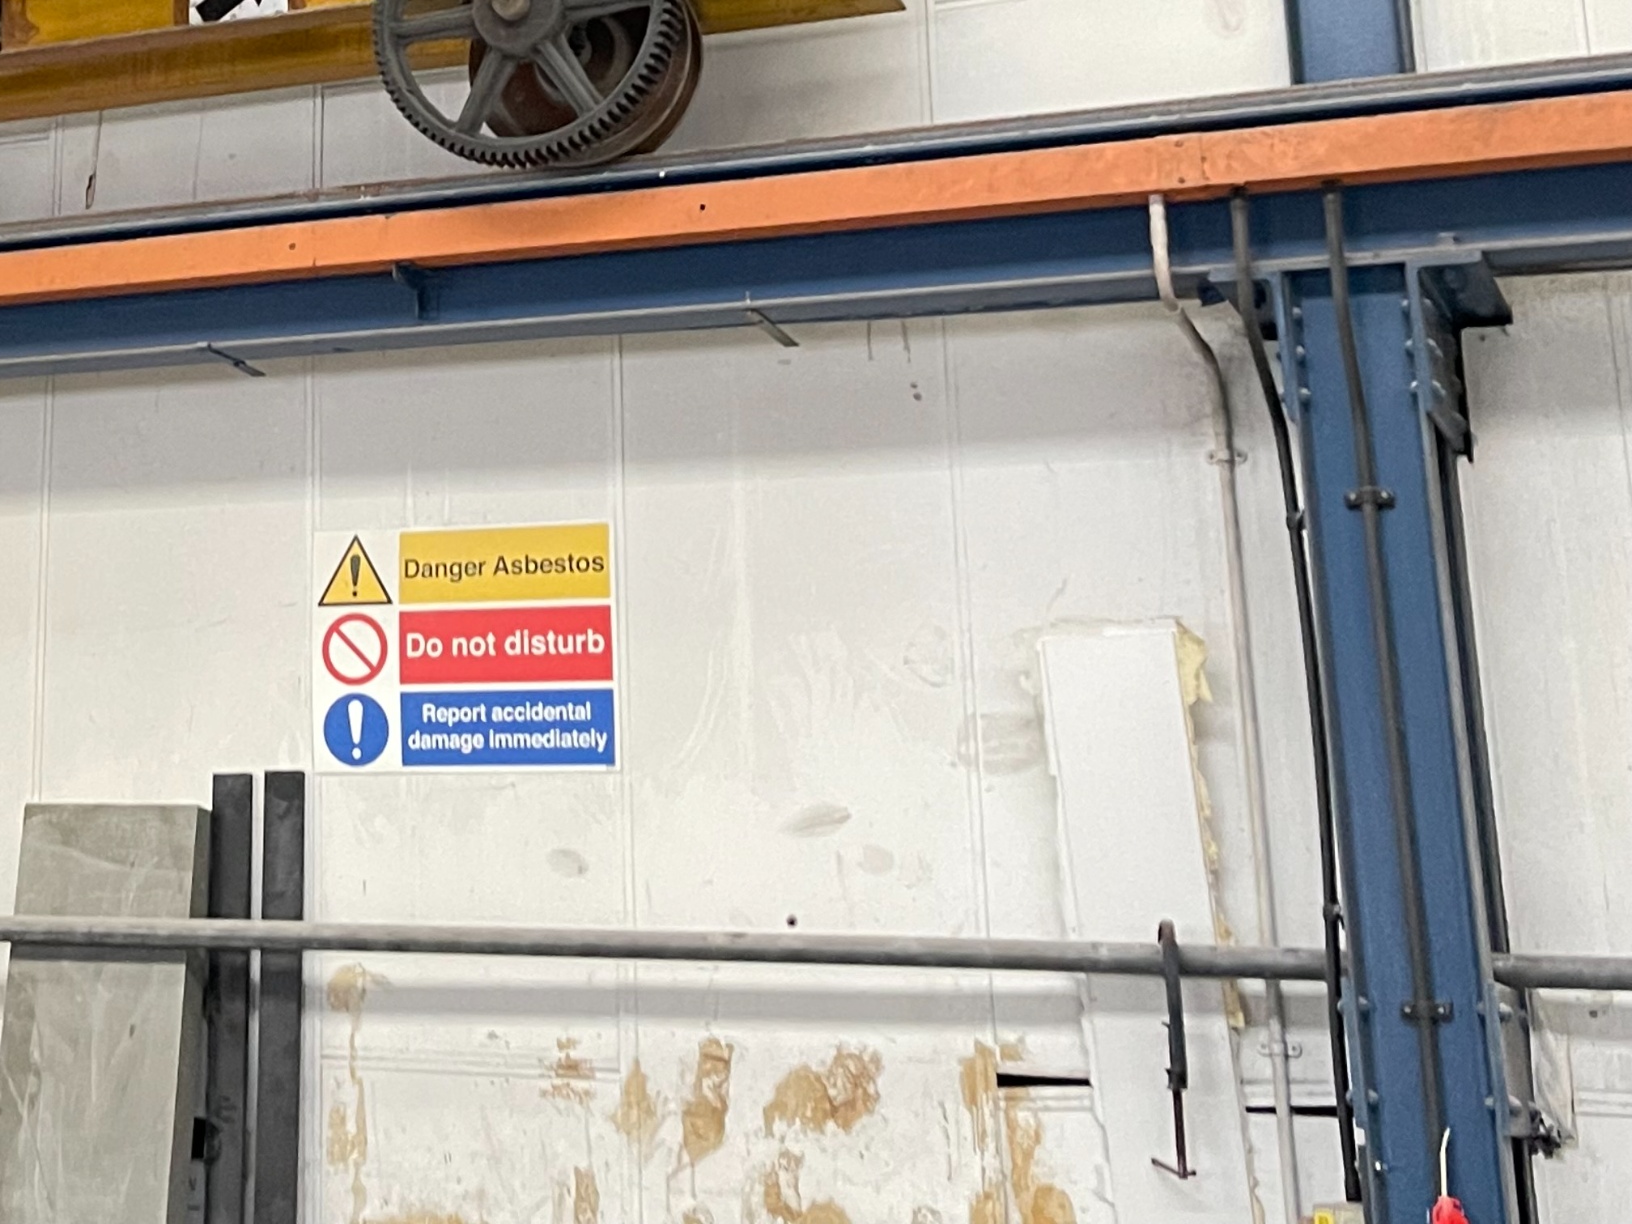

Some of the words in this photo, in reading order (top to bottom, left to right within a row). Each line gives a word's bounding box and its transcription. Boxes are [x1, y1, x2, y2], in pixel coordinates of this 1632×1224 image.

[404, 558, 486, 582] Danger
[493, 554, 605, 576] Asbestos
[406, 633, 443, 658] Do
[452, 632, 496, 657] not
[504, 629, 606, 655] disturb
[422, 702, 487, 727] Report
[492, 701, 591, 722] accidental
[408, 729, 485, 753] damage
[489, 728, 607, 752] immediately
